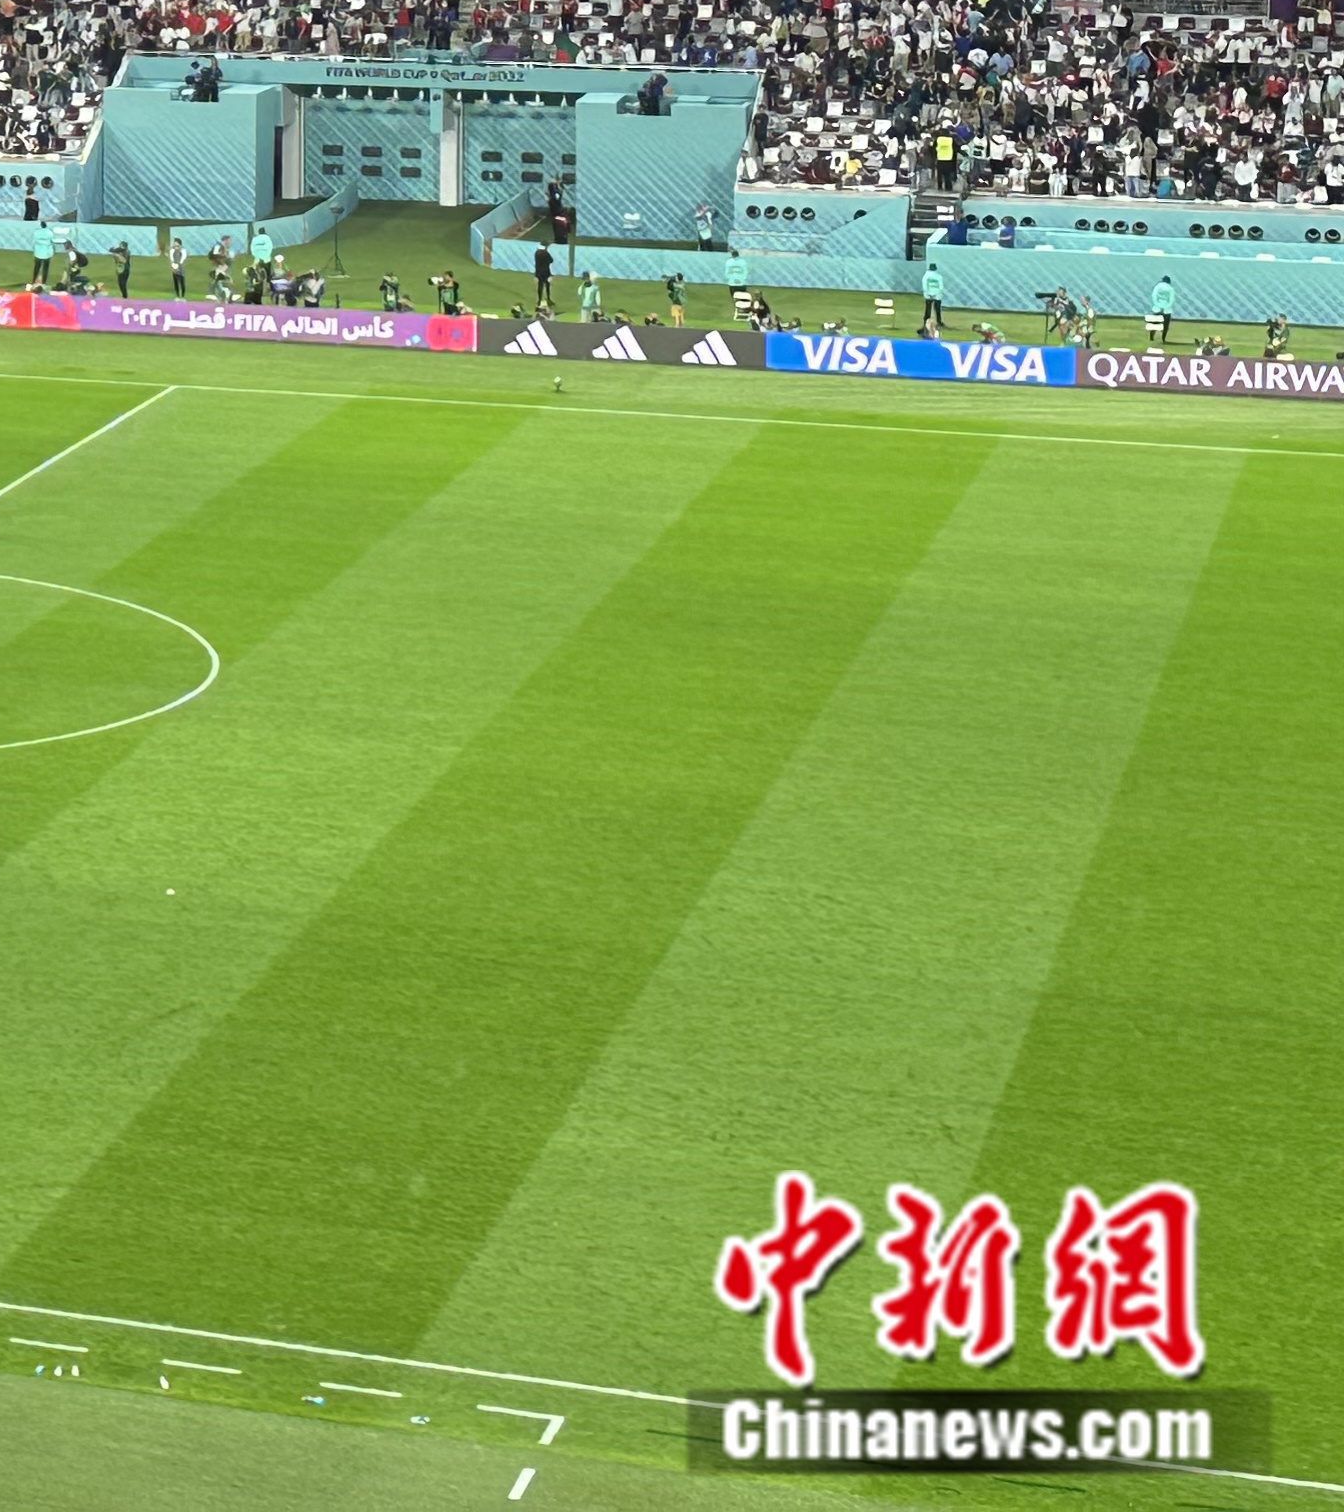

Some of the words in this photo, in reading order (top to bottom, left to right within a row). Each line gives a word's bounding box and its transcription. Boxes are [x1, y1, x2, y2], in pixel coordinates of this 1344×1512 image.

[162, 306, 226, 332] قطر
[234, 313, 278, 332] FIFA
[281, 312, 338, 339] العالم
[342, 315, 394, 341] كأس
[794, 333, 898, 375] VISA
[940, 341, 1046, 382] VISA
[1087, 352, 1213, 389] QATAR
[1227, 360, 1344, 394] AIRWA
